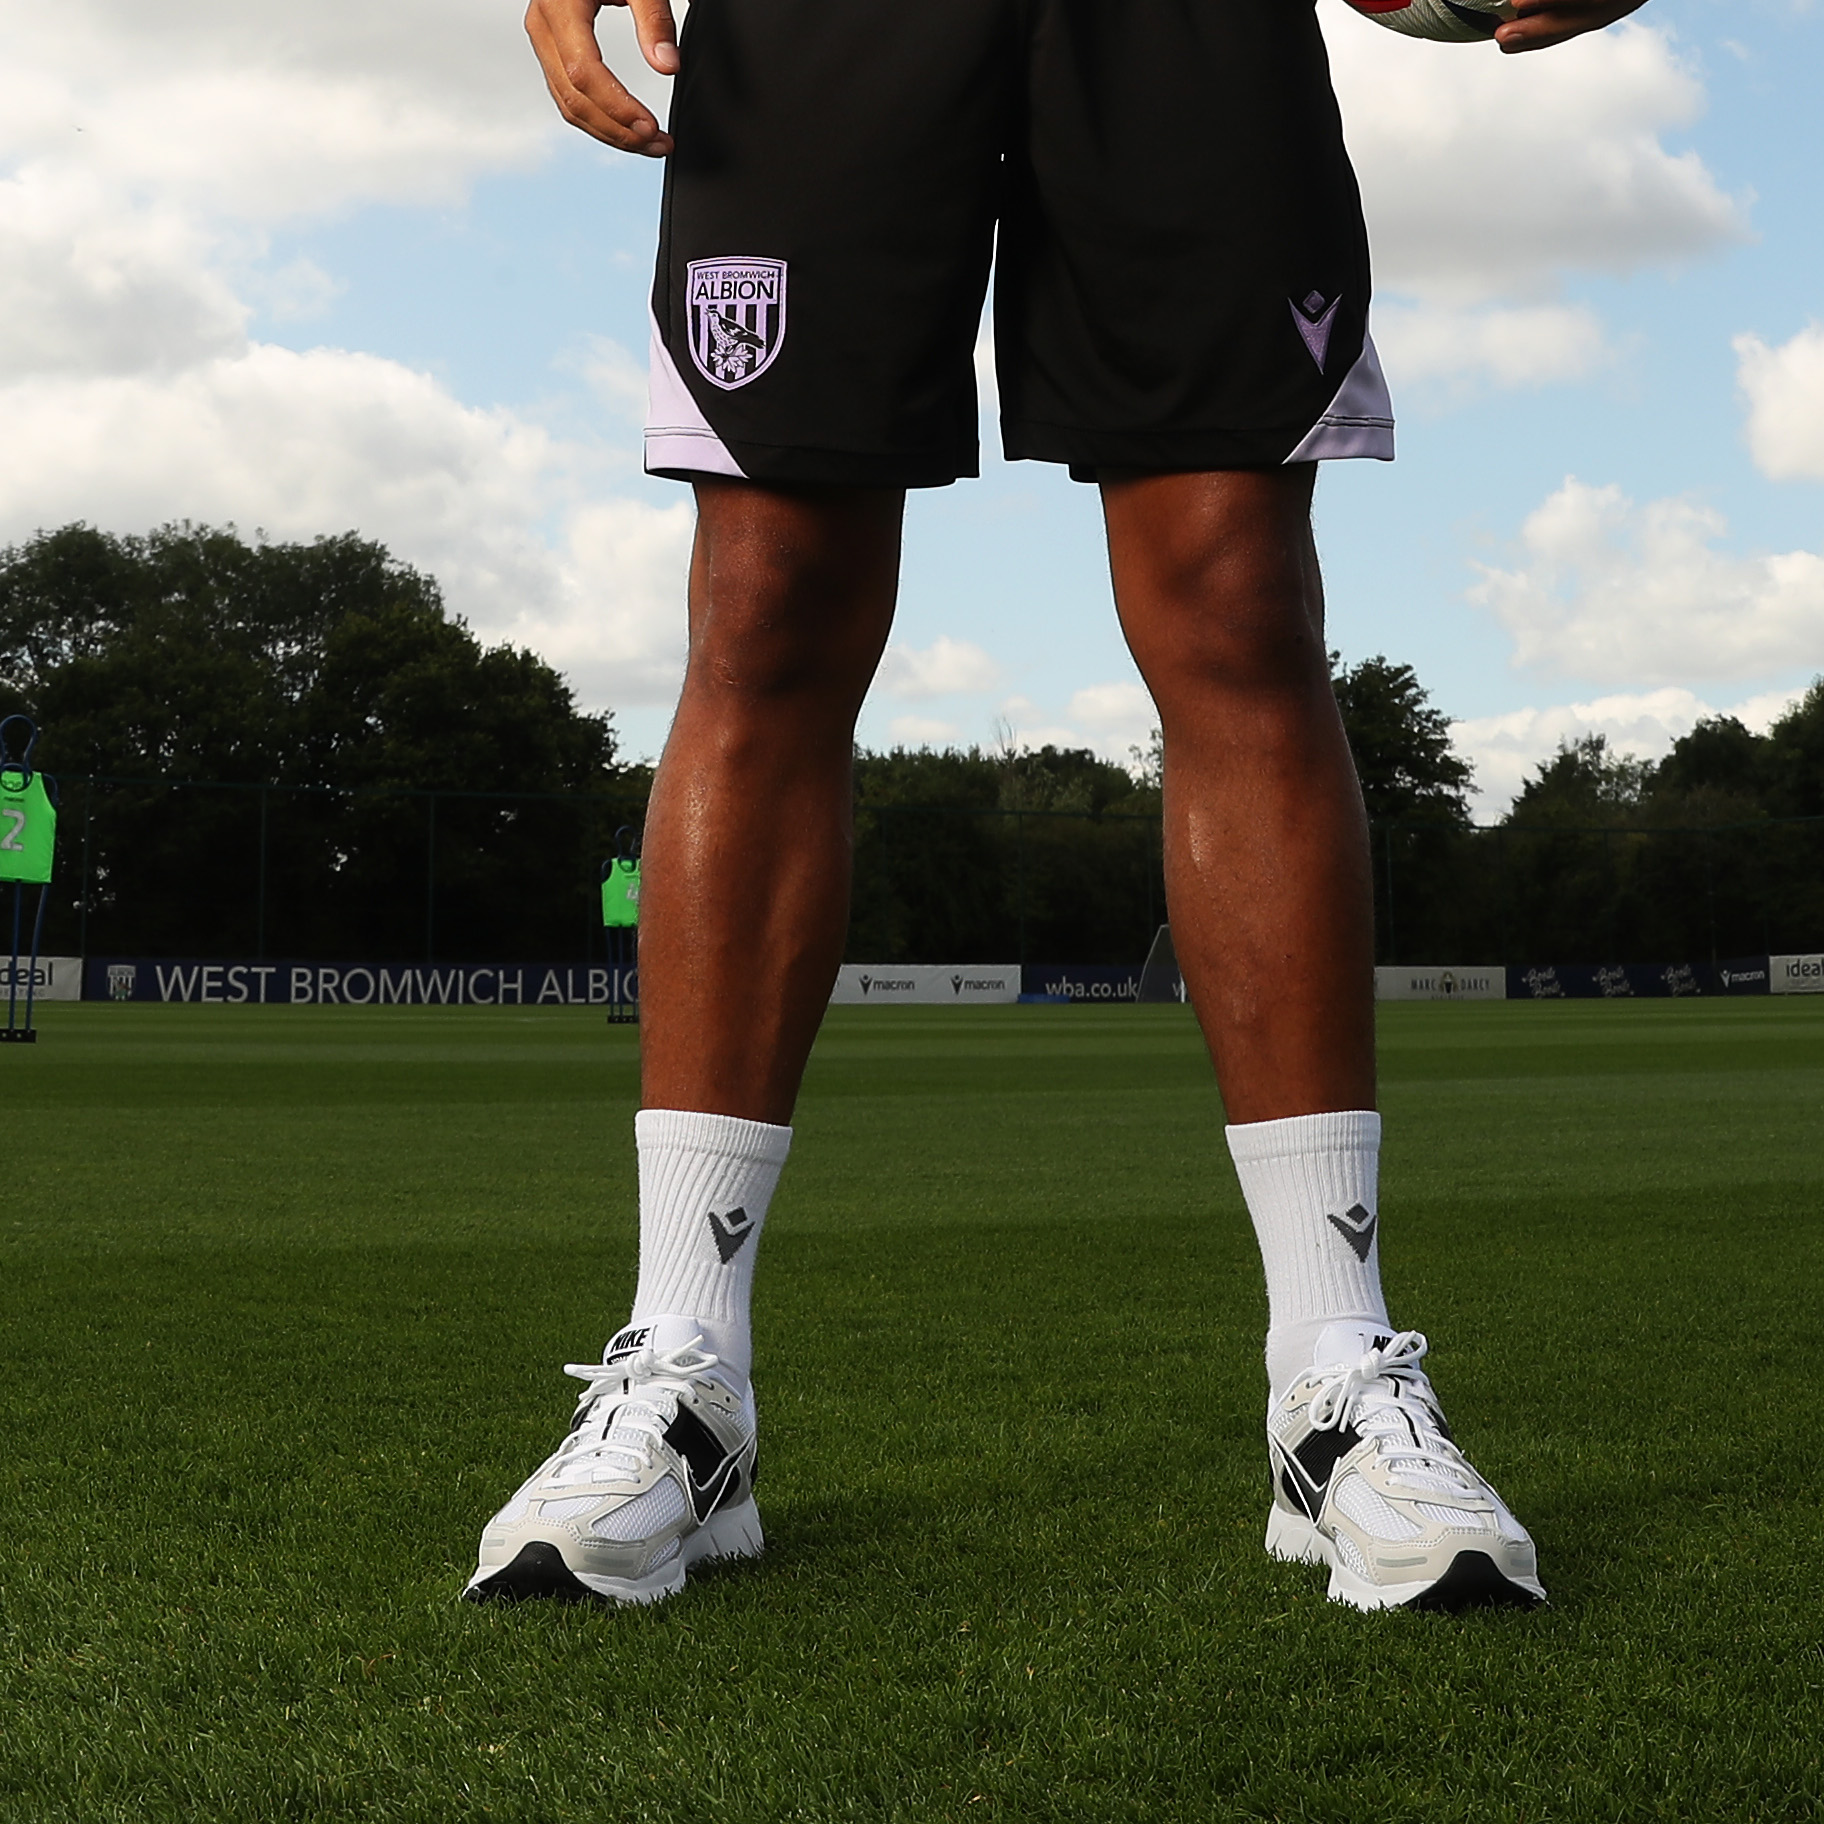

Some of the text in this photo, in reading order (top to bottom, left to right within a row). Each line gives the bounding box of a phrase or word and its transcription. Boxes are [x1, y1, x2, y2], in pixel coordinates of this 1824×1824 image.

[697, 270, 775, 280] WEST BROMWICH
[696, 280, 775, 301] ALBION
[0, 808, 26, 851] 2
[155, 965, 639, 1004] WEST BROMWICH ALBIO
[1731, 969, 1765, 983] macron
[873, 979, 915, 991] macron
[964, 979, 1006, 991] macron
[1045, 976, 1138, 999] wba.co.uk
[1411, 979, 1490, 992] MARC DARCY
[610, 1327, 651, 1354] NIKE
